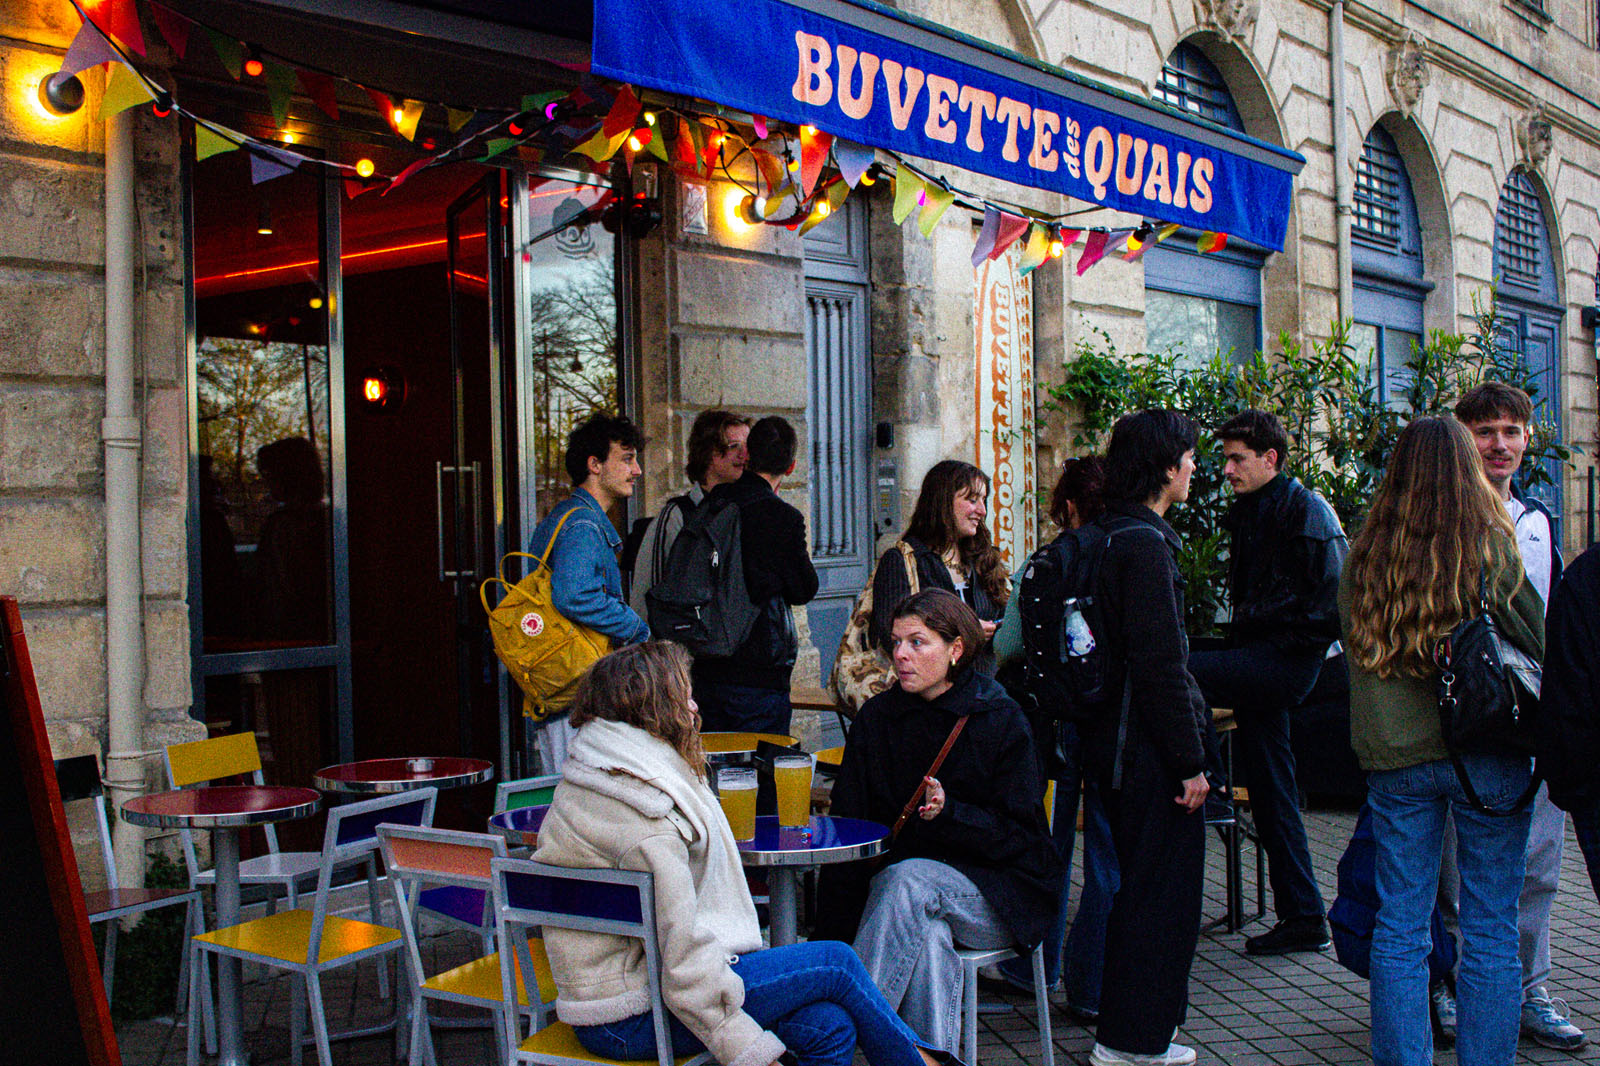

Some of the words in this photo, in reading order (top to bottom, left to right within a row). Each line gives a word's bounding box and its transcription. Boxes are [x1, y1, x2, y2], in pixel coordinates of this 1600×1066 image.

[792, 30, 1060, 172] BUVETTE
[1063, 117, 1080, 179] des
[1084, 126, 1214, 213] QUAIS
[990, 281, 1013, 448] BUVETTE
[993, 462, 1014, 574] COCKT
